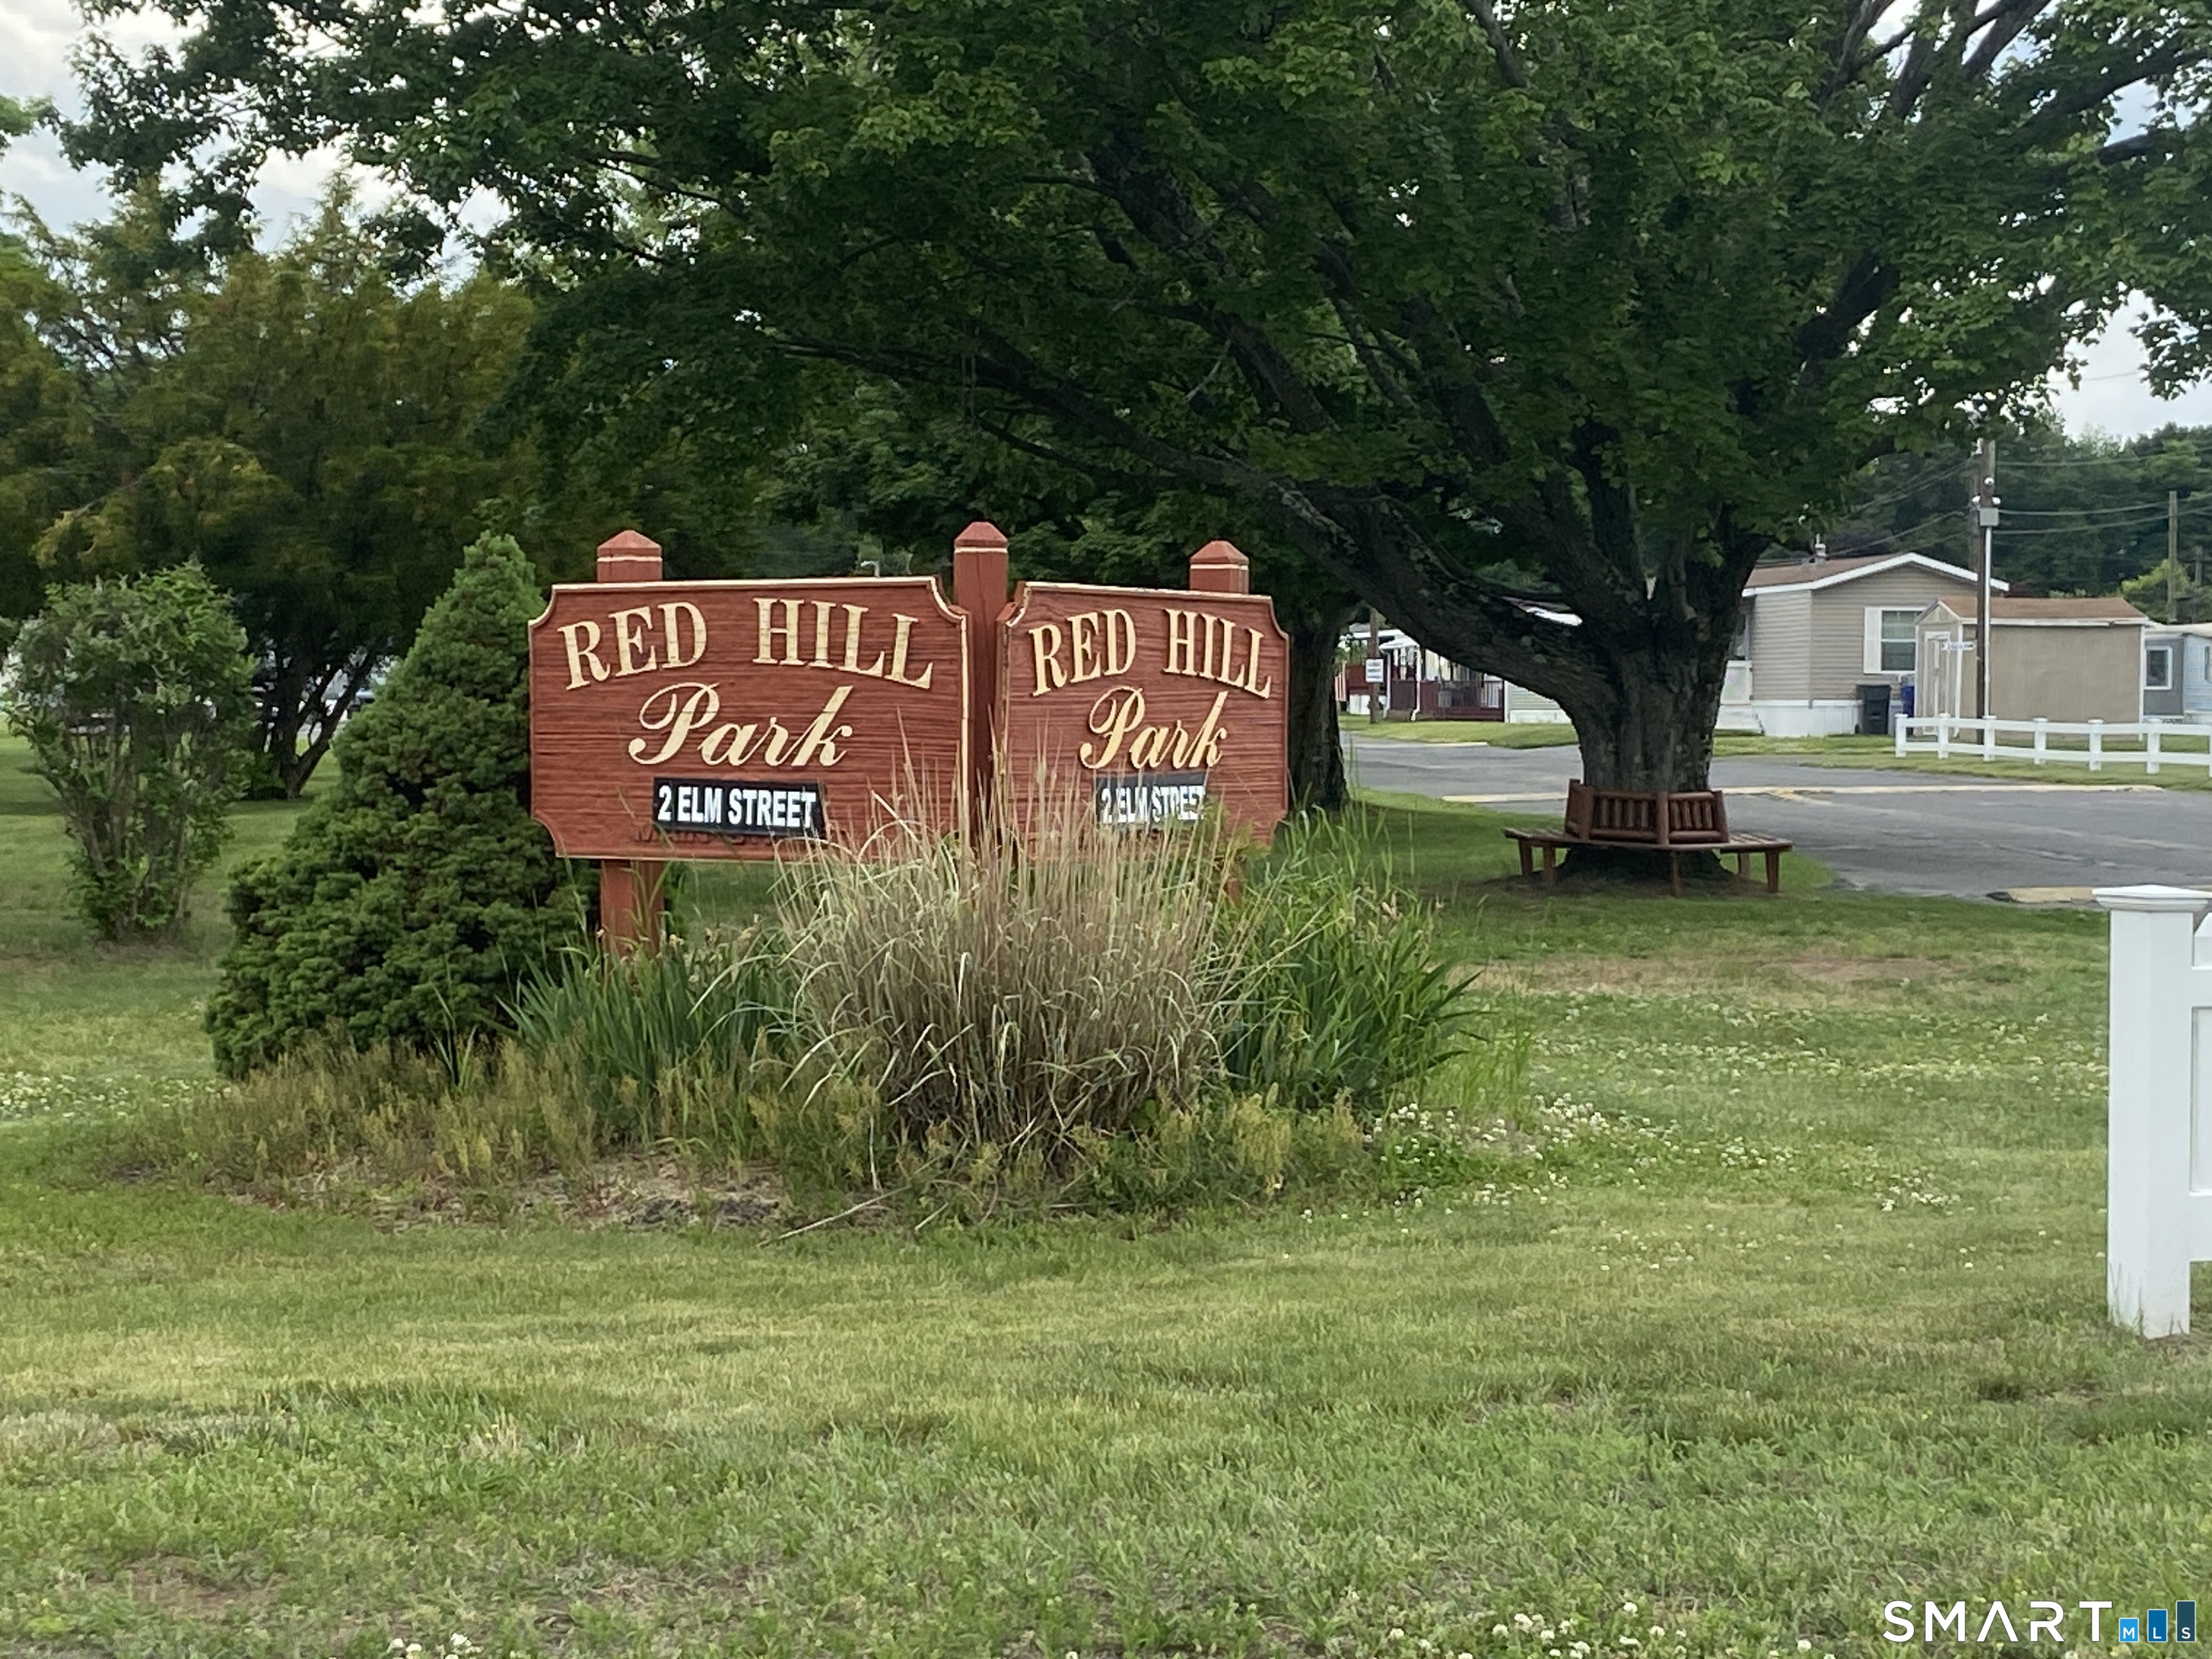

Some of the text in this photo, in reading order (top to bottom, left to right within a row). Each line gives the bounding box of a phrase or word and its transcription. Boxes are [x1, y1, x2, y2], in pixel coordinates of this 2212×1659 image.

[557, 597, 933, 691] RED HILL
[1028, 608, 1272, 699] RED HILL
[628, 682, 854, 767] Park
[1079, 684, 1229, 770] Park
[657, 785, 816, 828] 2 ELM STREET
[1101, 788, 1112, 823] 2
[1116, 786, 1148, 823] ELM
